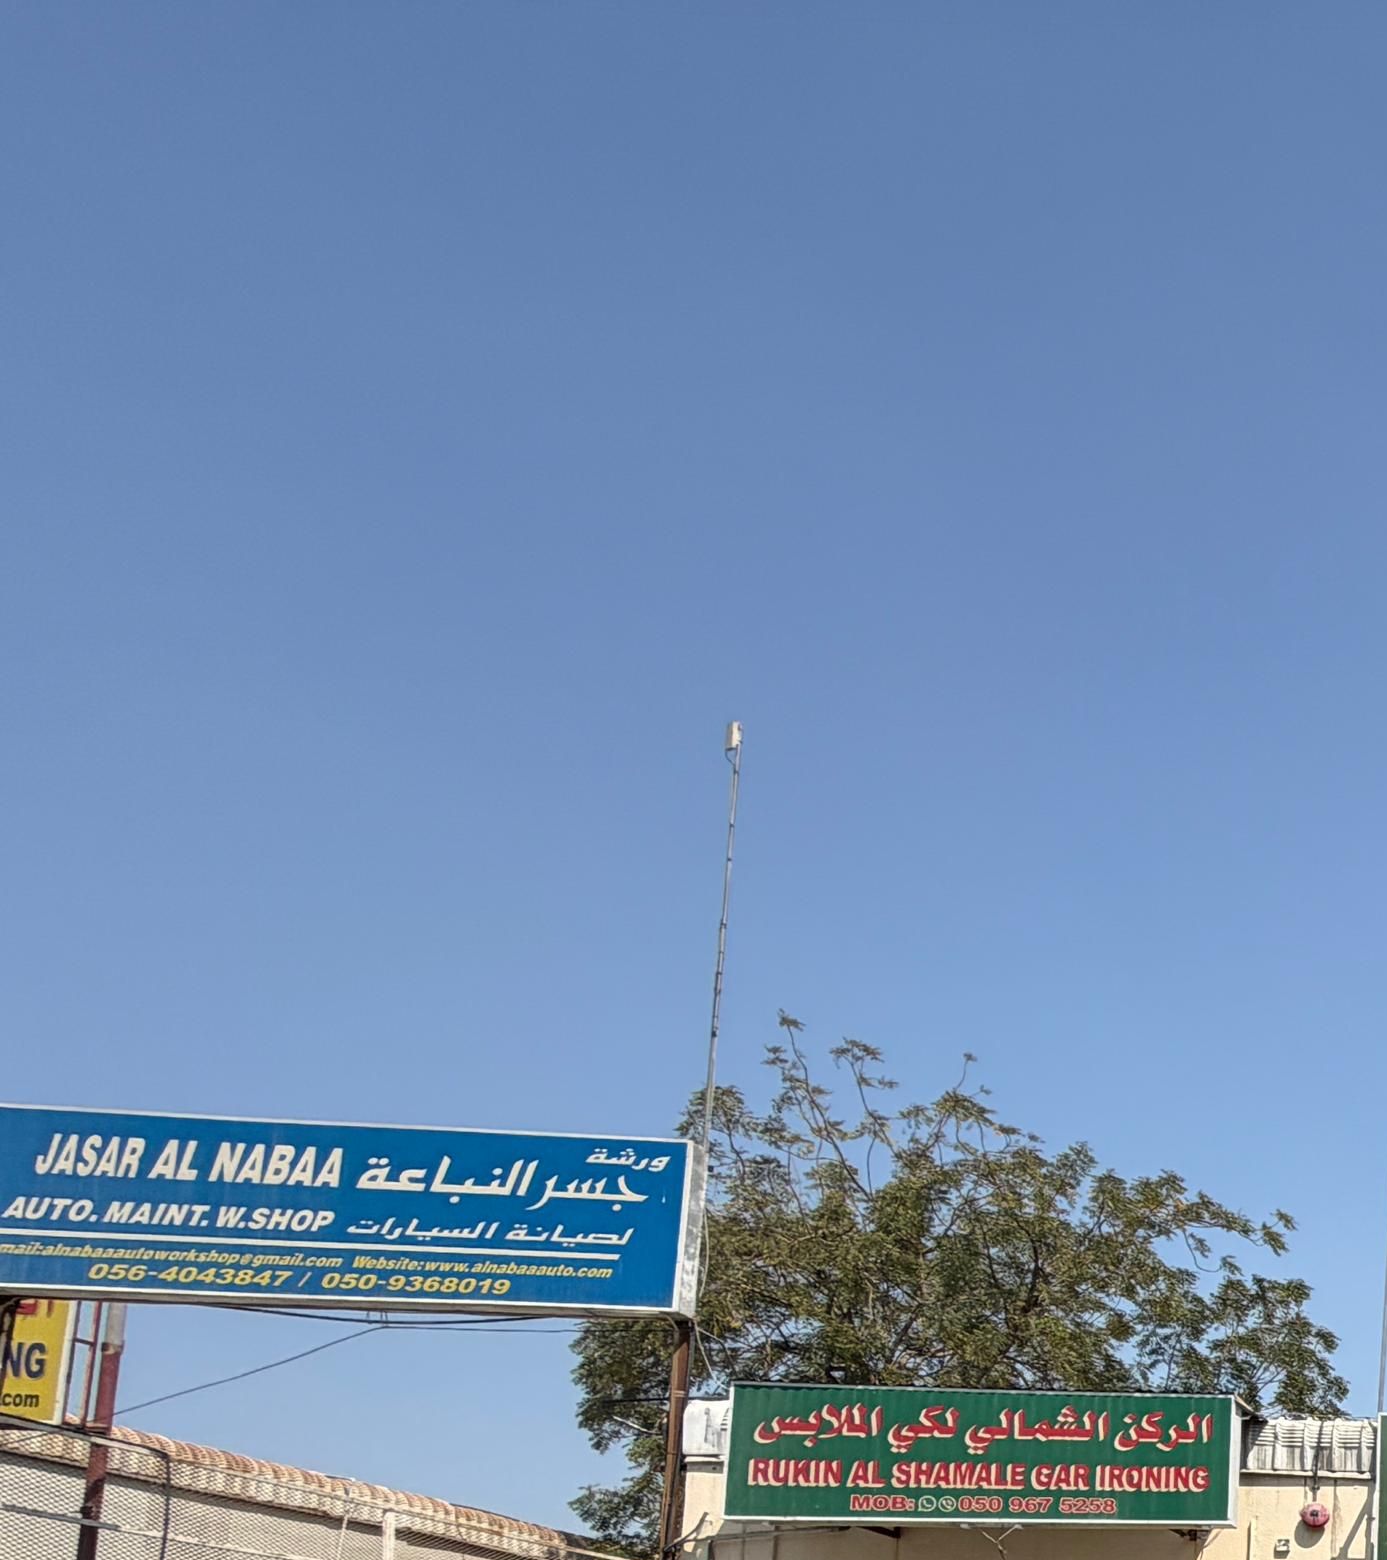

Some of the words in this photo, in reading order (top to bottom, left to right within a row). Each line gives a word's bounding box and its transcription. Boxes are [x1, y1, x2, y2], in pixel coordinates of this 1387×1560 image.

[34, 1132, 146, 1178] JASAR
[147, 1138, 199, 1181] AL
[208, 1142, 344, 1188] NABAA
[585, 1148, 672, 1172] ورشة
[355, 1155, 540, 1204] النباعة
[525, 1174, 649, 1212] جسر
[1, 1196, 98, 1222] AUTO.
[102, 1201, 210, 1227] MAINT.
[216, 1206, 335, 1232] W.SHOP
[346, 1217, 501, 1241] السيارات
[504, 1224, 635, 1247] لصيانة
[88, 1263, 294, 1288] 056-4043847
[321, 1273, 511, 1295] 050-9368019
[753, 1402, 882, 1448] الملابس
[887, 1405, 960, 1453] لكي
[965, 1404, 1110, 1455] الشمالي
[1113, 1411, 1213, 1452] الركن
[747, 1458, 842, 1488] RUKIN
[846, 1460, 886, 1489] AL
[891, 1461, 1026, 1491] SHAMALE
[1030, 1464, 1090, 1492] GAR
[1096, 1466, 1211, 1493] IRONING
[850, 1494, 915, 1512] MOB:
[957, 1496, 1003, 1513] 050
[1007, 1496, 1053, 1513] 967
[1058, 1497, 1118, 1514] 5258
